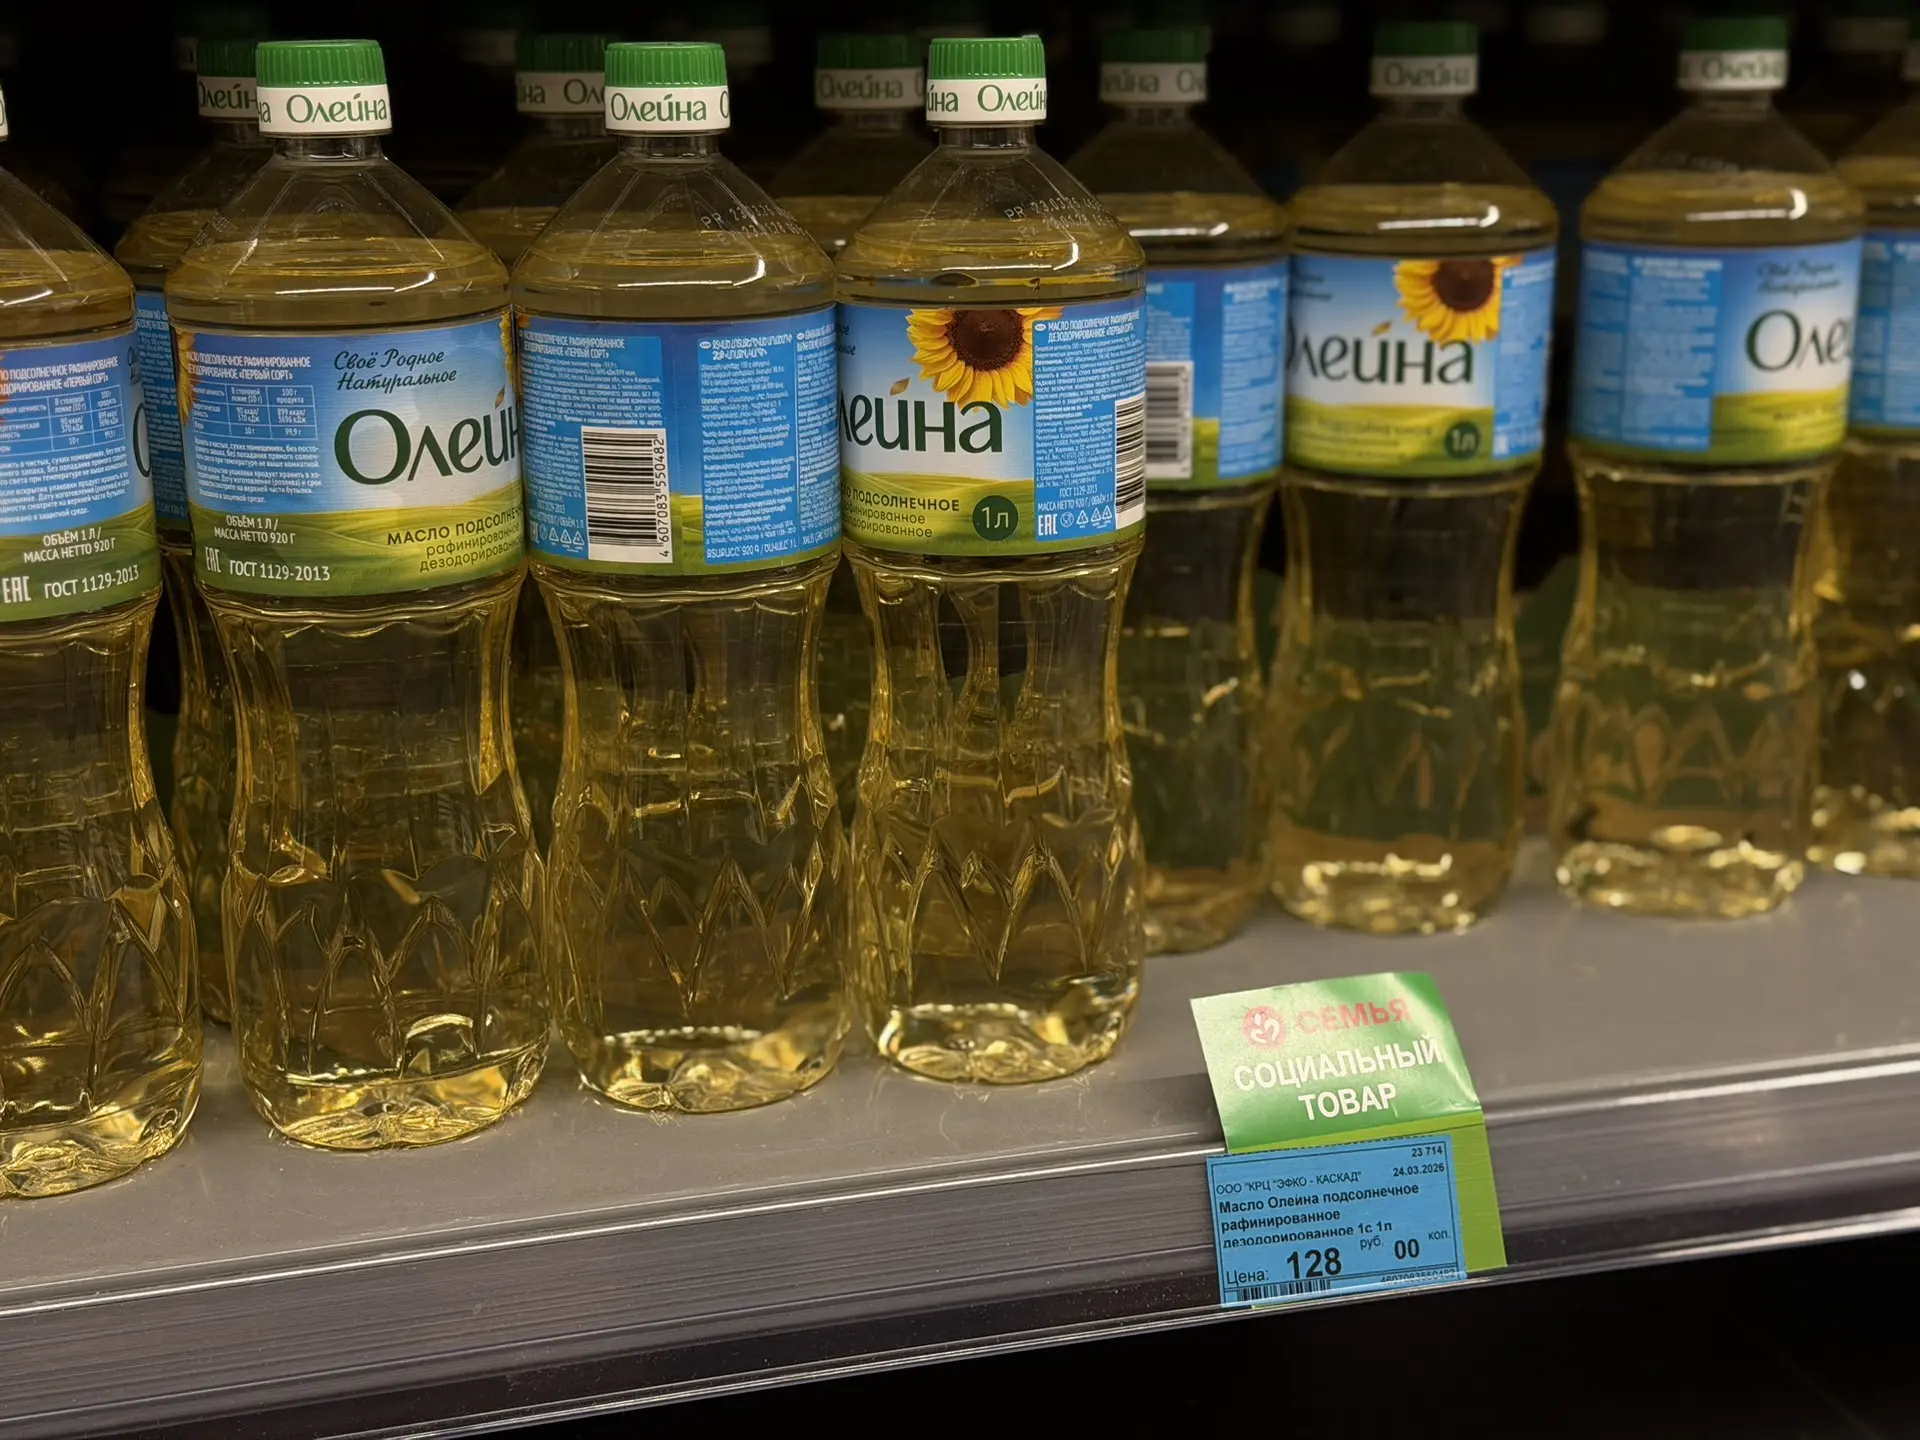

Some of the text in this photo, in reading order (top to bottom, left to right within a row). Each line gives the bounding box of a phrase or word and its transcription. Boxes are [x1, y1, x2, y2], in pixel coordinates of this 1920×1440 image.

[286, 93, 388, 123] Олейна
[611, 93, 707, 122] Олейна
[10, 364, 68, 380] ПОДСОЛНЕЧНОЕ
[334, 348, 445, 372] Своё Родное
[271, 370, 293, 380] СОРТ»
[337, 370, 458, 394] Натуральное
[653, 438, 667, 487] 550482
[853, 488, 960, 512] ПОДСОЛНЕЧНОЕ
[226, 514, 255, 528] ОБЪЁМ
[257, 518, 263, 529] 1
[265, 518, 272, 529] Л
[656, 494, 670, 543] 607083
[43, 531, 79, 547] ОБЪЁМ
[81, 529, 86, 541] 1
[88, 528, 96, 541] Л
[214, 527, 296, 544] МАССА НЕТТО 920 Г
[388, 526, 450, 545] МАСЛО
[24, 537, 116, 564] МАССА НЕТТО 920 Г
[44, 564, 140, 599] ГОСТ 1129-2013
[229, 559, 331, 581] ГОСТ 1129-2013
[1296, 998, 1415, 1035] СЕМЬЯ
[1234, 1034, 1443, 1091] СОЦИАЛЬНЫЙ
[1298, 1083, 1397, 1121] ТОВАР
[1392, 1163, 1445, 1177] 24.03.2026
[1217, 1183, 1242, 1195] ООО
[1316, 1171, 1362, 1185] КАСКАД"
[1219, 1198, 1264, 1214] Масло
[1324, 1183, 1420, 1204] подсолнечное
[1221, 1209, 1341, 1234] рафинированное
[1359, 1229, 1451, 1251] руб. коп.
[1226, 1238, 1420, 1286] Цена: 128 00
